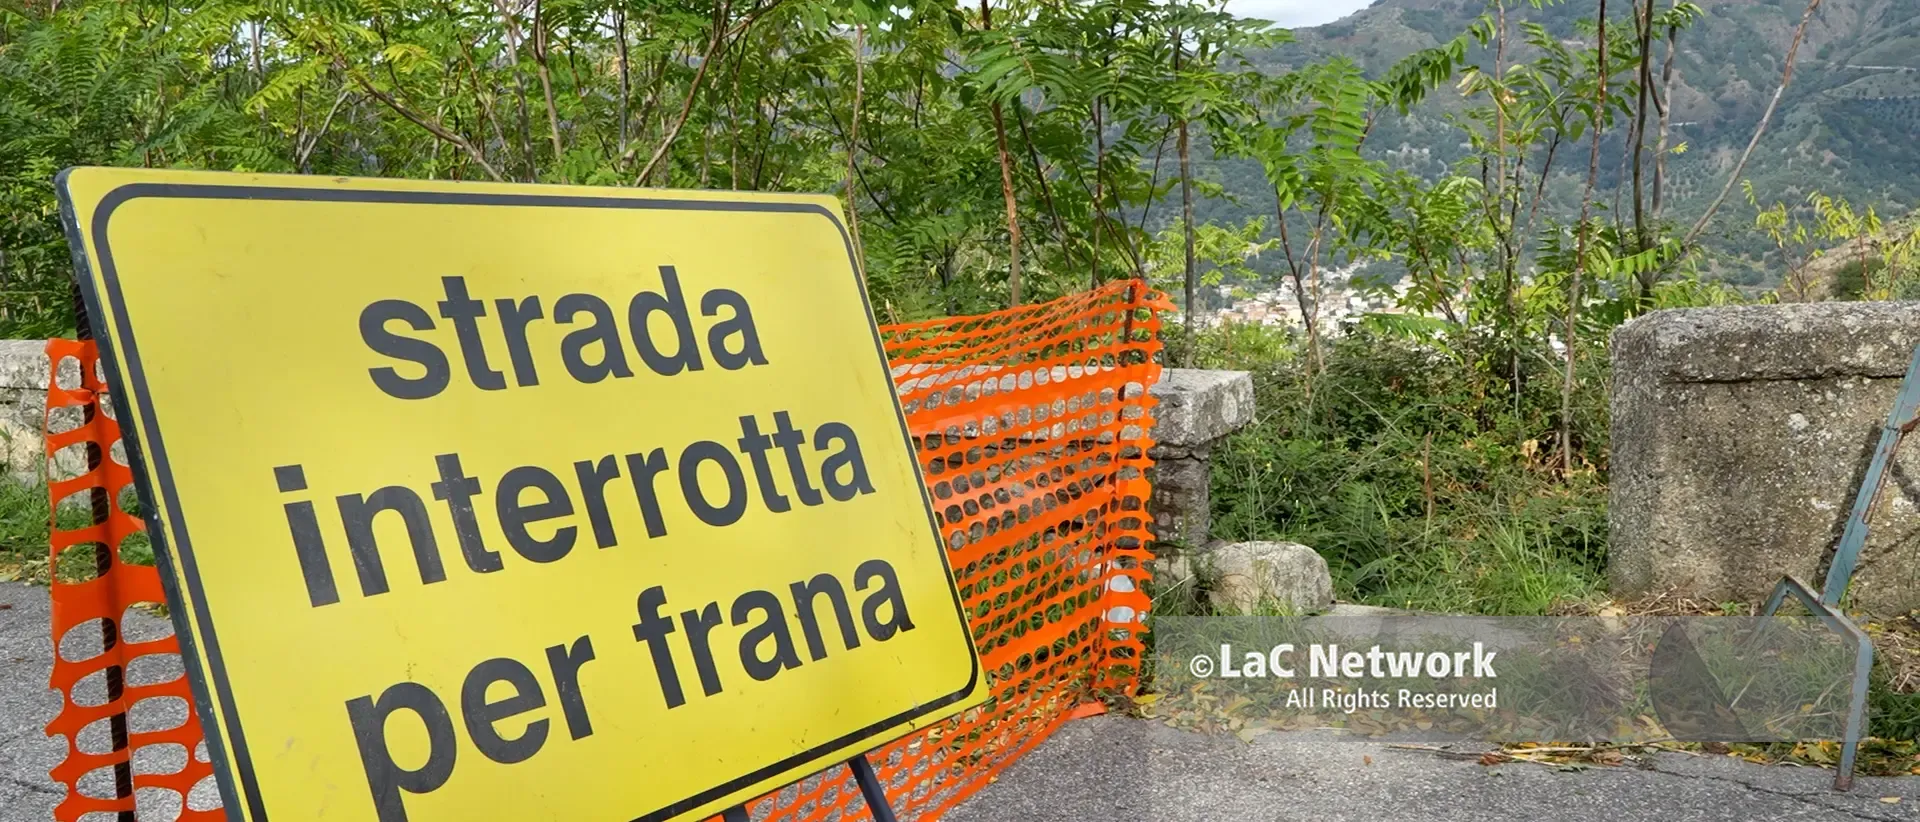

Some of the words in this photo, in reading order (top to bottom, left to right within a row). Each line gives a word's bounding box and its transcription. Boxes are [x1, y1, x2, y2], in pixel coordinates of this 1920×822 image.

[358, 265, 769, 400] strada
[273, 411, 876, 608] interrotta
[346, 635, 596, 822] per
[631, 560, 916, 710] frana
